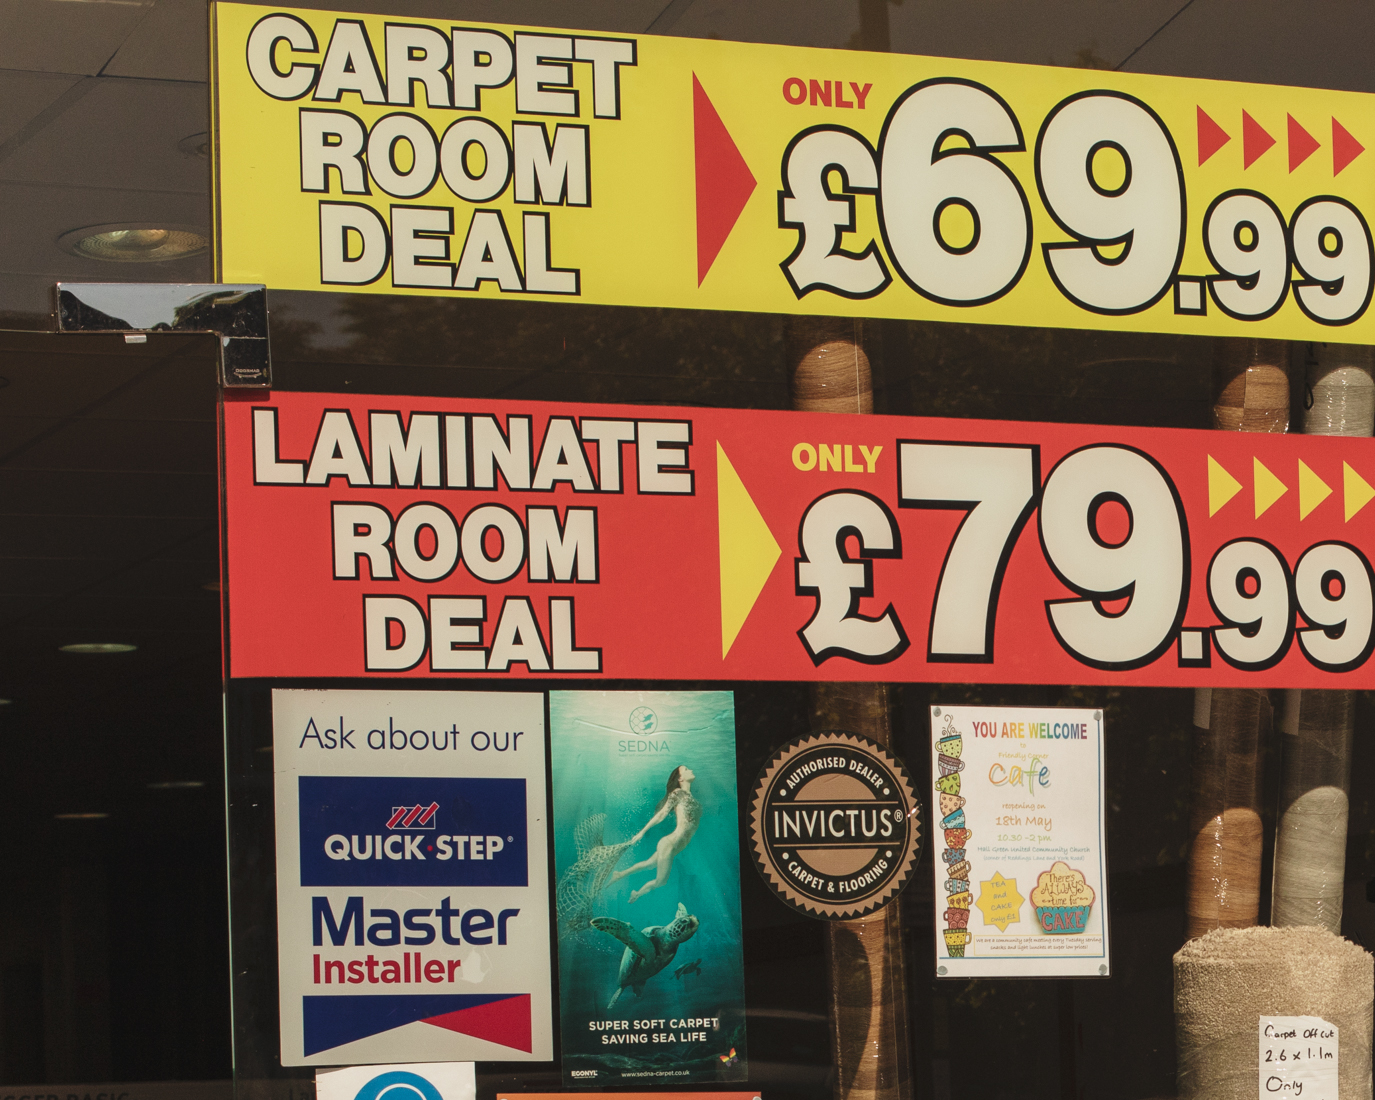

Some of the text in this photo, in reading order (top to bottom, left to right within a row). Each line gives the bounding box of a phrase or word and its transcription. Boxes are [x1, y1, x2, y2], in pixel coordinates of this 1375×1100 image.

[246, 12, 636, 119] CARPET
[782, 78, 872, 109] ONLY
[300, 107, 591, 207] ROOM
[777, 77, 1375, 326] £69.99
[319, 200, 581, 295] DEAL
[251, 406, 695, 496] LAMINATE
[792, 443, 882, 473] ONLY
[331, 500, 598, 583] ROOM
[363, 593, 602, 672] DEAL
[299, 716, 523, 752] Ask about our
[972, 721, 1087, 740] YOU ARE WELCOME
[618, 740, 670, 752] SEDNA
[998, 752, 1026, 761] Friendly
[786, 757, 884, 789] AUTHORISED DEALER
[1002, 803, 1035, 811] reopening
[995, 816, 1052, 831] 18th May
[324, 834, 426, 861] QUICK
[788, 859, 888, 893] CARPET & FLOORING
[312, 896, 520, 946] Master
[1042, 912, 1085, 931] CAKE
[313, 952, 460, 984] Installer
[589, 1018, 718, 1031] SUPER SOFT CARPET
[602, 1032, 707, 1045] SAVING SEA LIFE
[1265, 1025, 1296, 1039] Carpet
[1265, 1047, 1332, 1062] 2.6 x 1.1m
[621, 1069, 690, 1078] www.sedna-carpet.co.uk
[1266, 1076, 1302, 1096] Only
